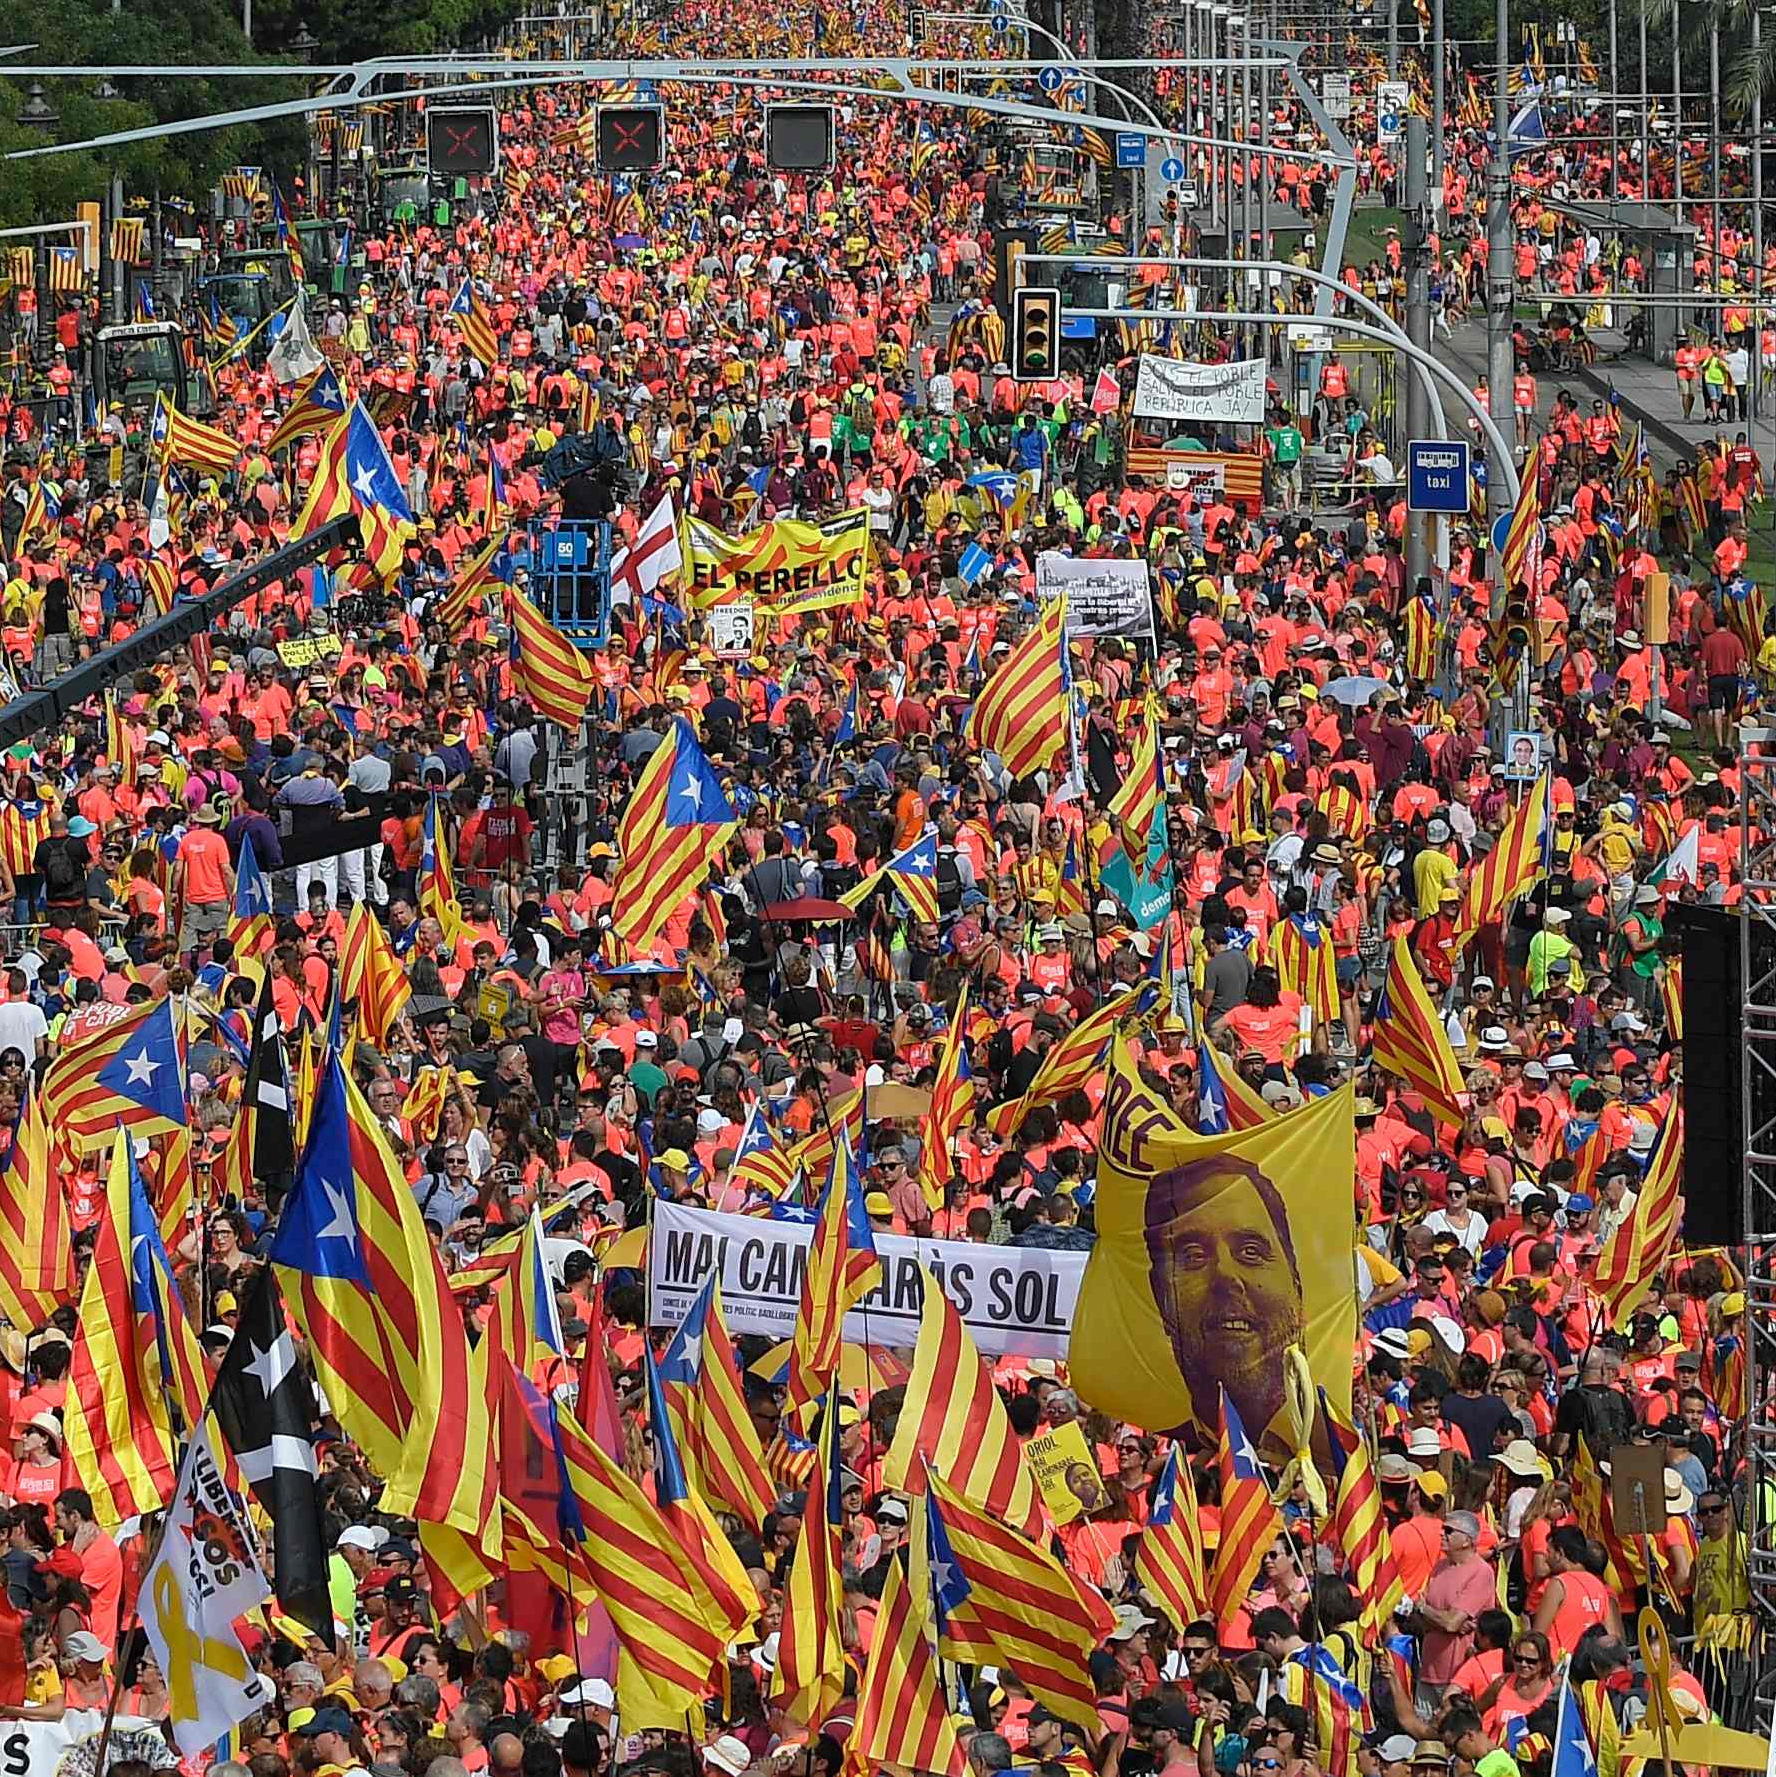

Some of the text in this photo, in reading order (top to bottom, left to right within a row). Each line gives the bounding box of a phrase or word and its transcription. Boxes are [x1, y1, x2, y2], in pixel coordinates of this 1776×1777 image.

[1427, 474, 1450, 488] taxi
[558, 542, 574, 553] 50
[693, 562, 727, 589] EL
[665, 1230, 729, 1288] MAI
[987, 1268, 1067, 1326] SOL
[1028, 1434, 1058, 1458] ORIOL
